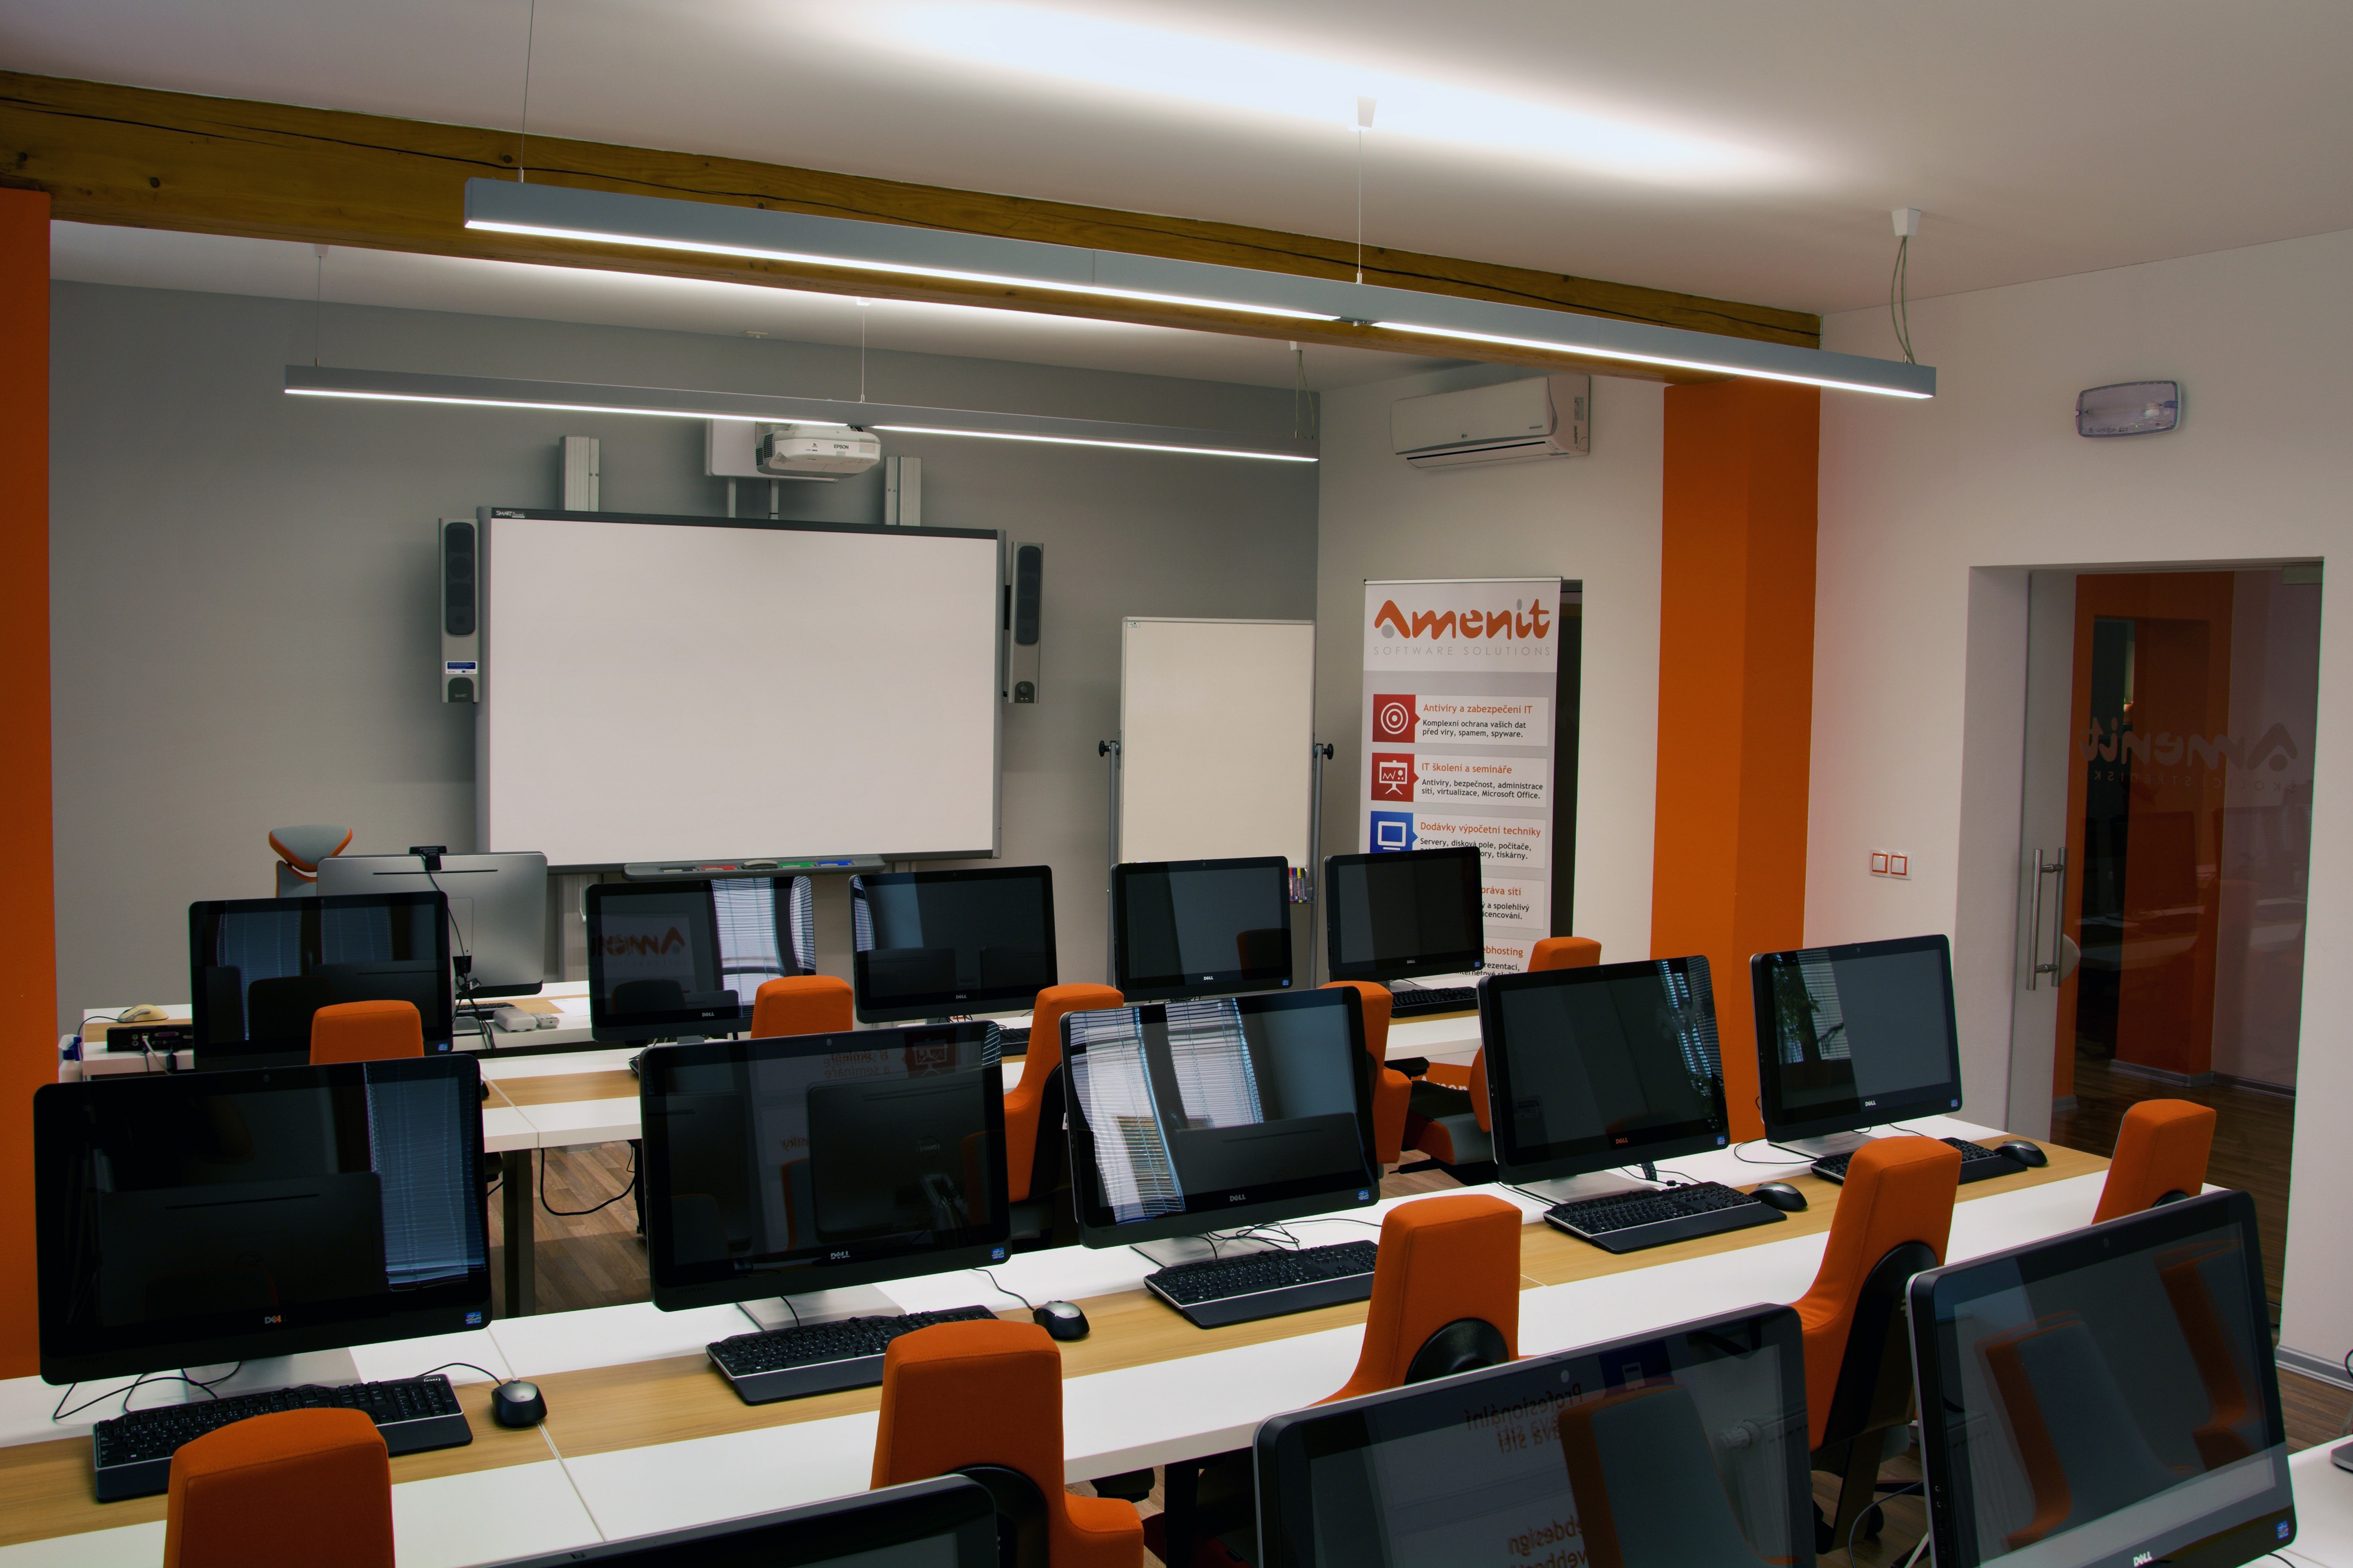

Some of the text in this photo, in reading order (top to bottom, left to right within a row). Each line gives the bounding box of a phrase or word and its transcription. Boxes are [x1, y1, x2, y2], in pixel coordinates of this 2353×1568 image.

[1374, 599, 1550, 640] Amenit
[1374, 646, 1550, 656] SOFTWARE SOLUTIONS
[1423, 704, 1457, 714] Antiviry
[1467, 705, 1521, 715] zabezpečení
[1524, 705, 1532, 713] IT
[1422, 719, 1459, 728] Komplexní
[1432, 763, 1462, 772] školení
[1472, 765, 1512, 774] semináře
[1422, 779, 1544, 790] Antiviry, bezpečnost, administrace
[1437, 788, 1479, 797] virtualizace,
[1517, 791, 1541, 799] Office.
[1421, 822, 1541, 838] Dodávky výpočetní techniky
[1420, 838, 1532, 851] Servery, disková pole, počítače,
[1497, 851, 1528, 860] tiskárny.
[1482, 886, 1521, 896] práva sítí
[1494, 903, 1529, 912] spolehlivý
[1482, 910, 1522, 920] icencování.
[1483, 946, 1523, 958] ebhosting
[1484, 963, 1519, 971] rezentací,
[1229, 1194, 1247, 1202] DELL
[830, 1250, 850, 1260] DELL
[2133, 1551, 2154, 1567] DELL
